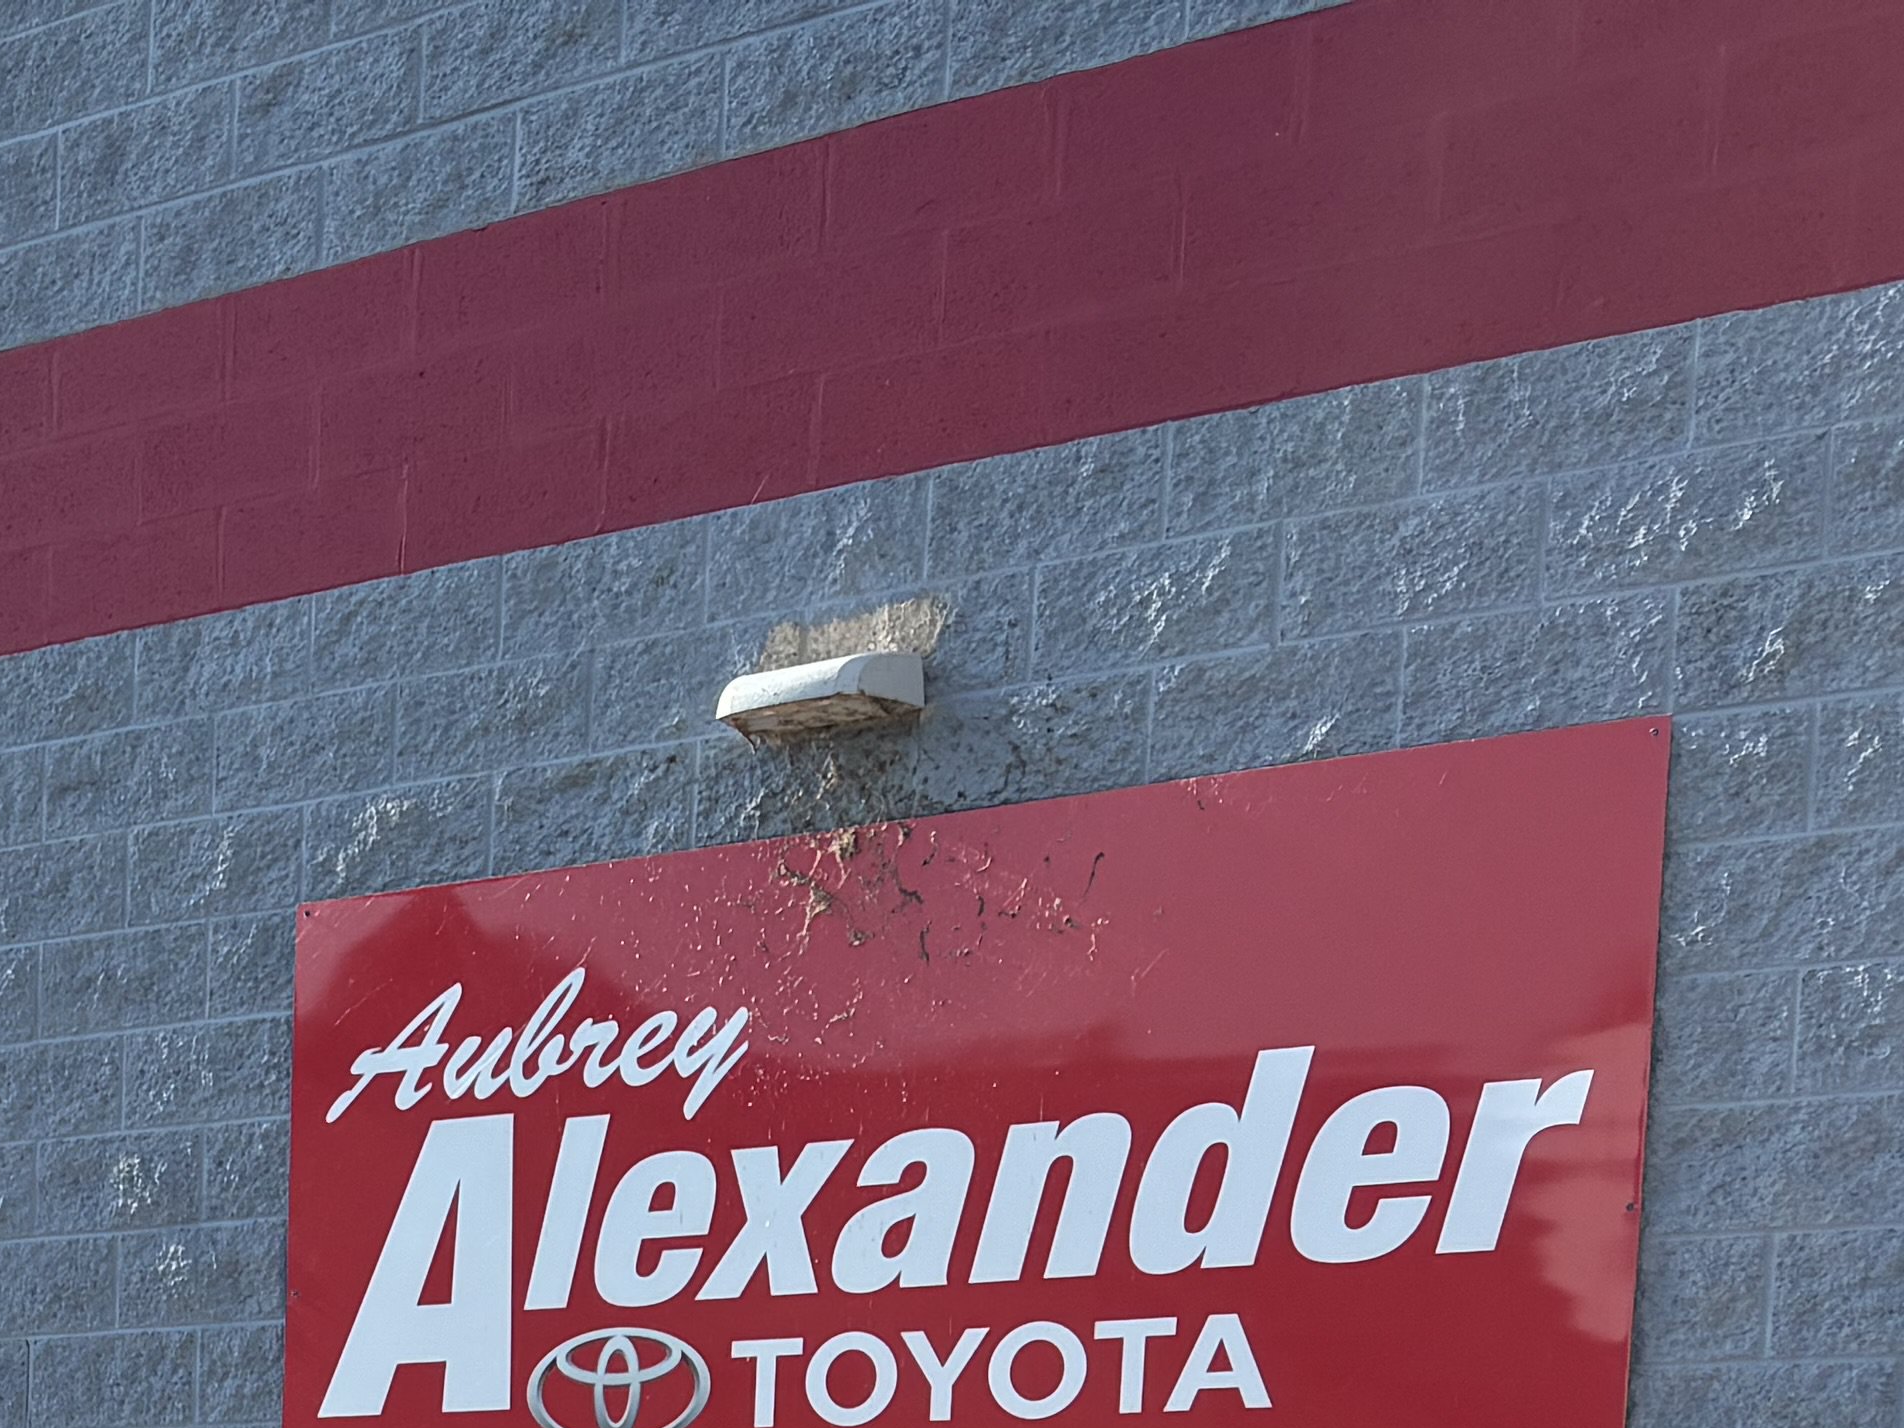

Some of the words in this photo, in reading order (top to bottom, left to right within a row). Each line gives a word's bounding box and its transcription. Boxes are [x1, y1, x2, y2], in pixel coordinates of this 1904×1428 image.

[325, 965, 753, 1124] Aubrey
[317, 1045, 1595, 1419] Alexander
[730, 1313, 1273, 1428] TOYOTA
